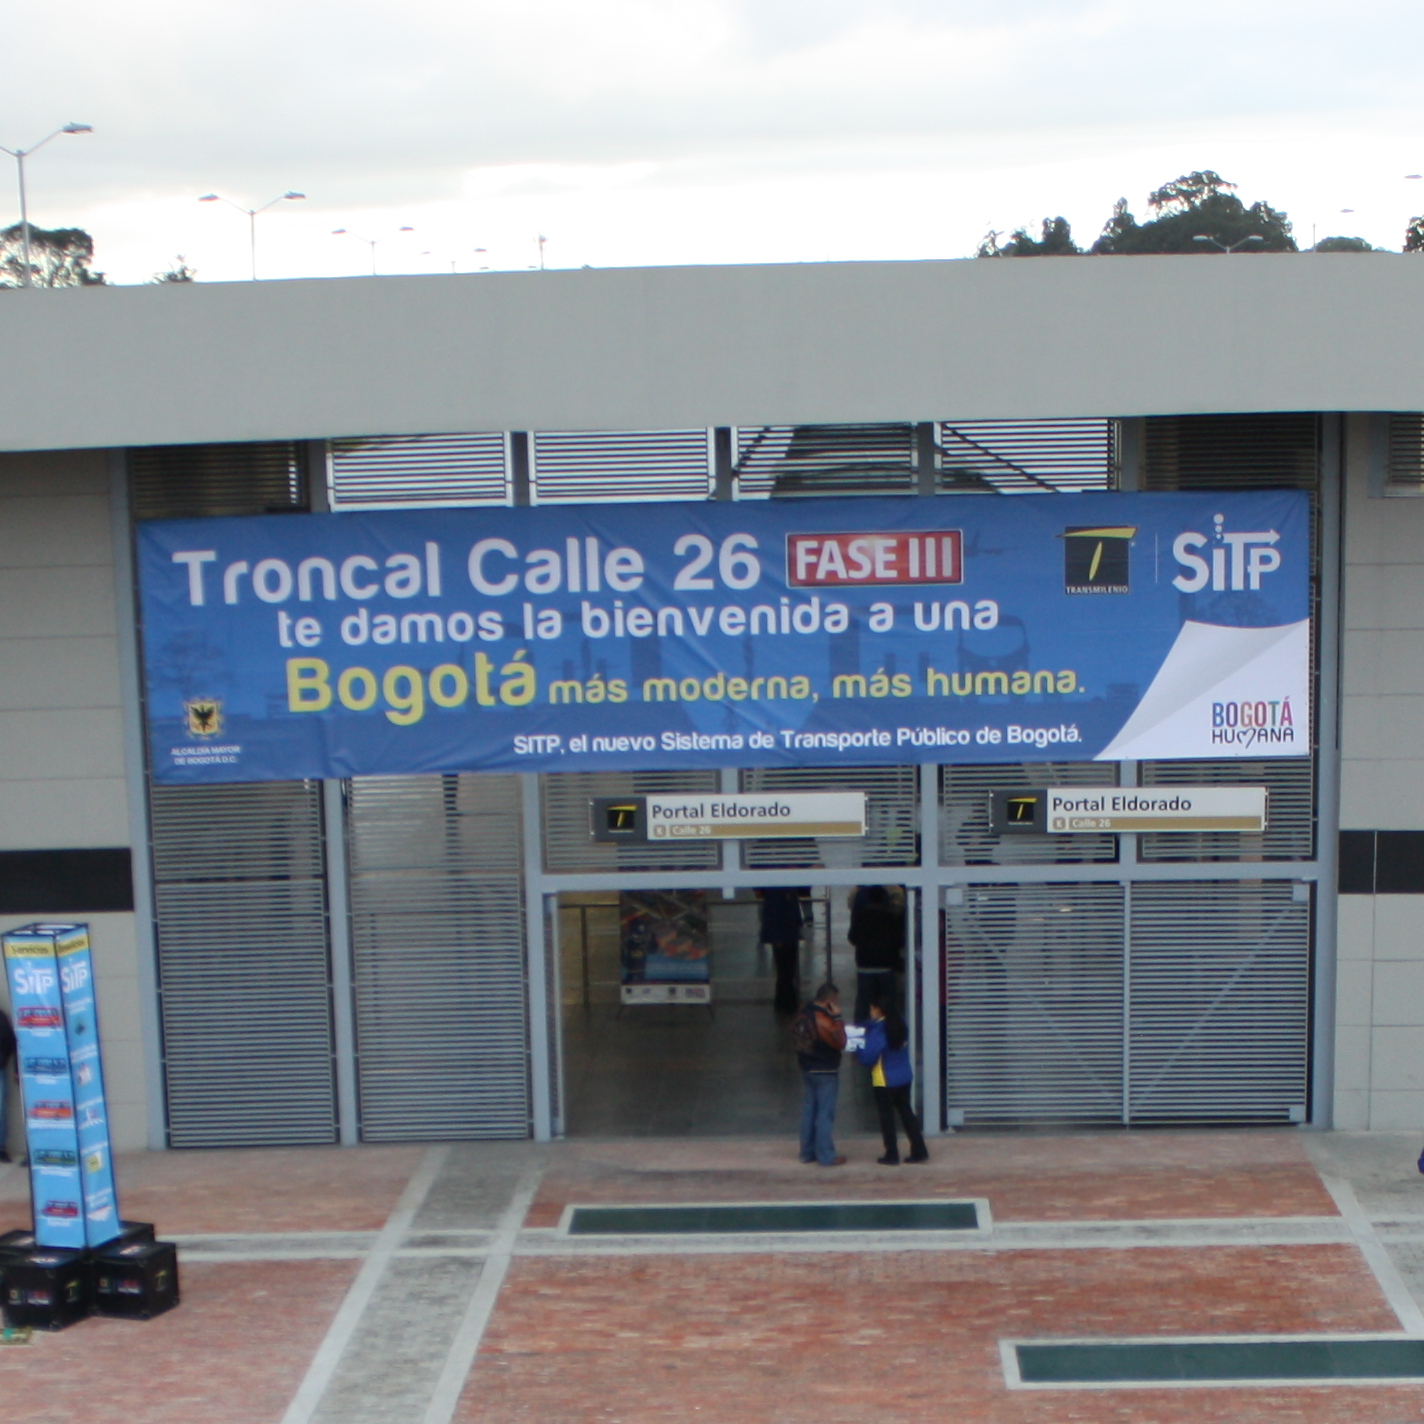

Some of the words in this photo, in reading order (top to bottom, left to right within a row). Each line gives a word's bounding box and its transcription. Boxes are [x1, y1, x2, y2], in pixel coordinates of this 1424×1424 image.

[171, 541, 441, 606] Troncal
[467, 536, 644, 596] Calle
[673, 533, 761, 590] 26
[796, 538, 897, 580] FASE
[909, 537, 953, 578] III
[1066, 585, 1128, 594] TRANSMILENIO
[277, 610, 321, 647] te
[340, 608, 504, 645] damos
[524, 602, 562, 639] la
[581, 597, 849, 638] bienvenida
[869, 602, 894, 632] a
[914, 600, 998, 631] una
[286, 649, 536, 726] Bogotá
[549, 673, 628, 704] más
[642, 672, 818, 703] moderna,
[832, 667, 912, 698] más
[927, 667, 1085, 697] humana.
[1212, 696, 1294, 728] BOGOTÁ
[513, 734, 565, 755] SITP,
[569, 732, 588, 751] el
[592, 735, 656, 752] nuevo
[661, 731, 744, 750] Sistema
[749, 731, 774, 749] de
[780, 729, 891, 751] Transporte
[897, 727, 970, 746] Público
[976, 726, 1001, 745] de
[1007, 724, 1082, 748] Bogotá.
[211, 745, 241, 755] MAYOR
[652, 803, 704, 819] Portal
[711, 802, 791, 818] Eldorado
[1053, 797, 1105, 812] Portal
[1112, 796, 1191, 811] Eldorado
[672, 825, 697, 836] Calle
[1072, 819, 1096, 829] Calle
[1098, 819, 1110, 828] 26
